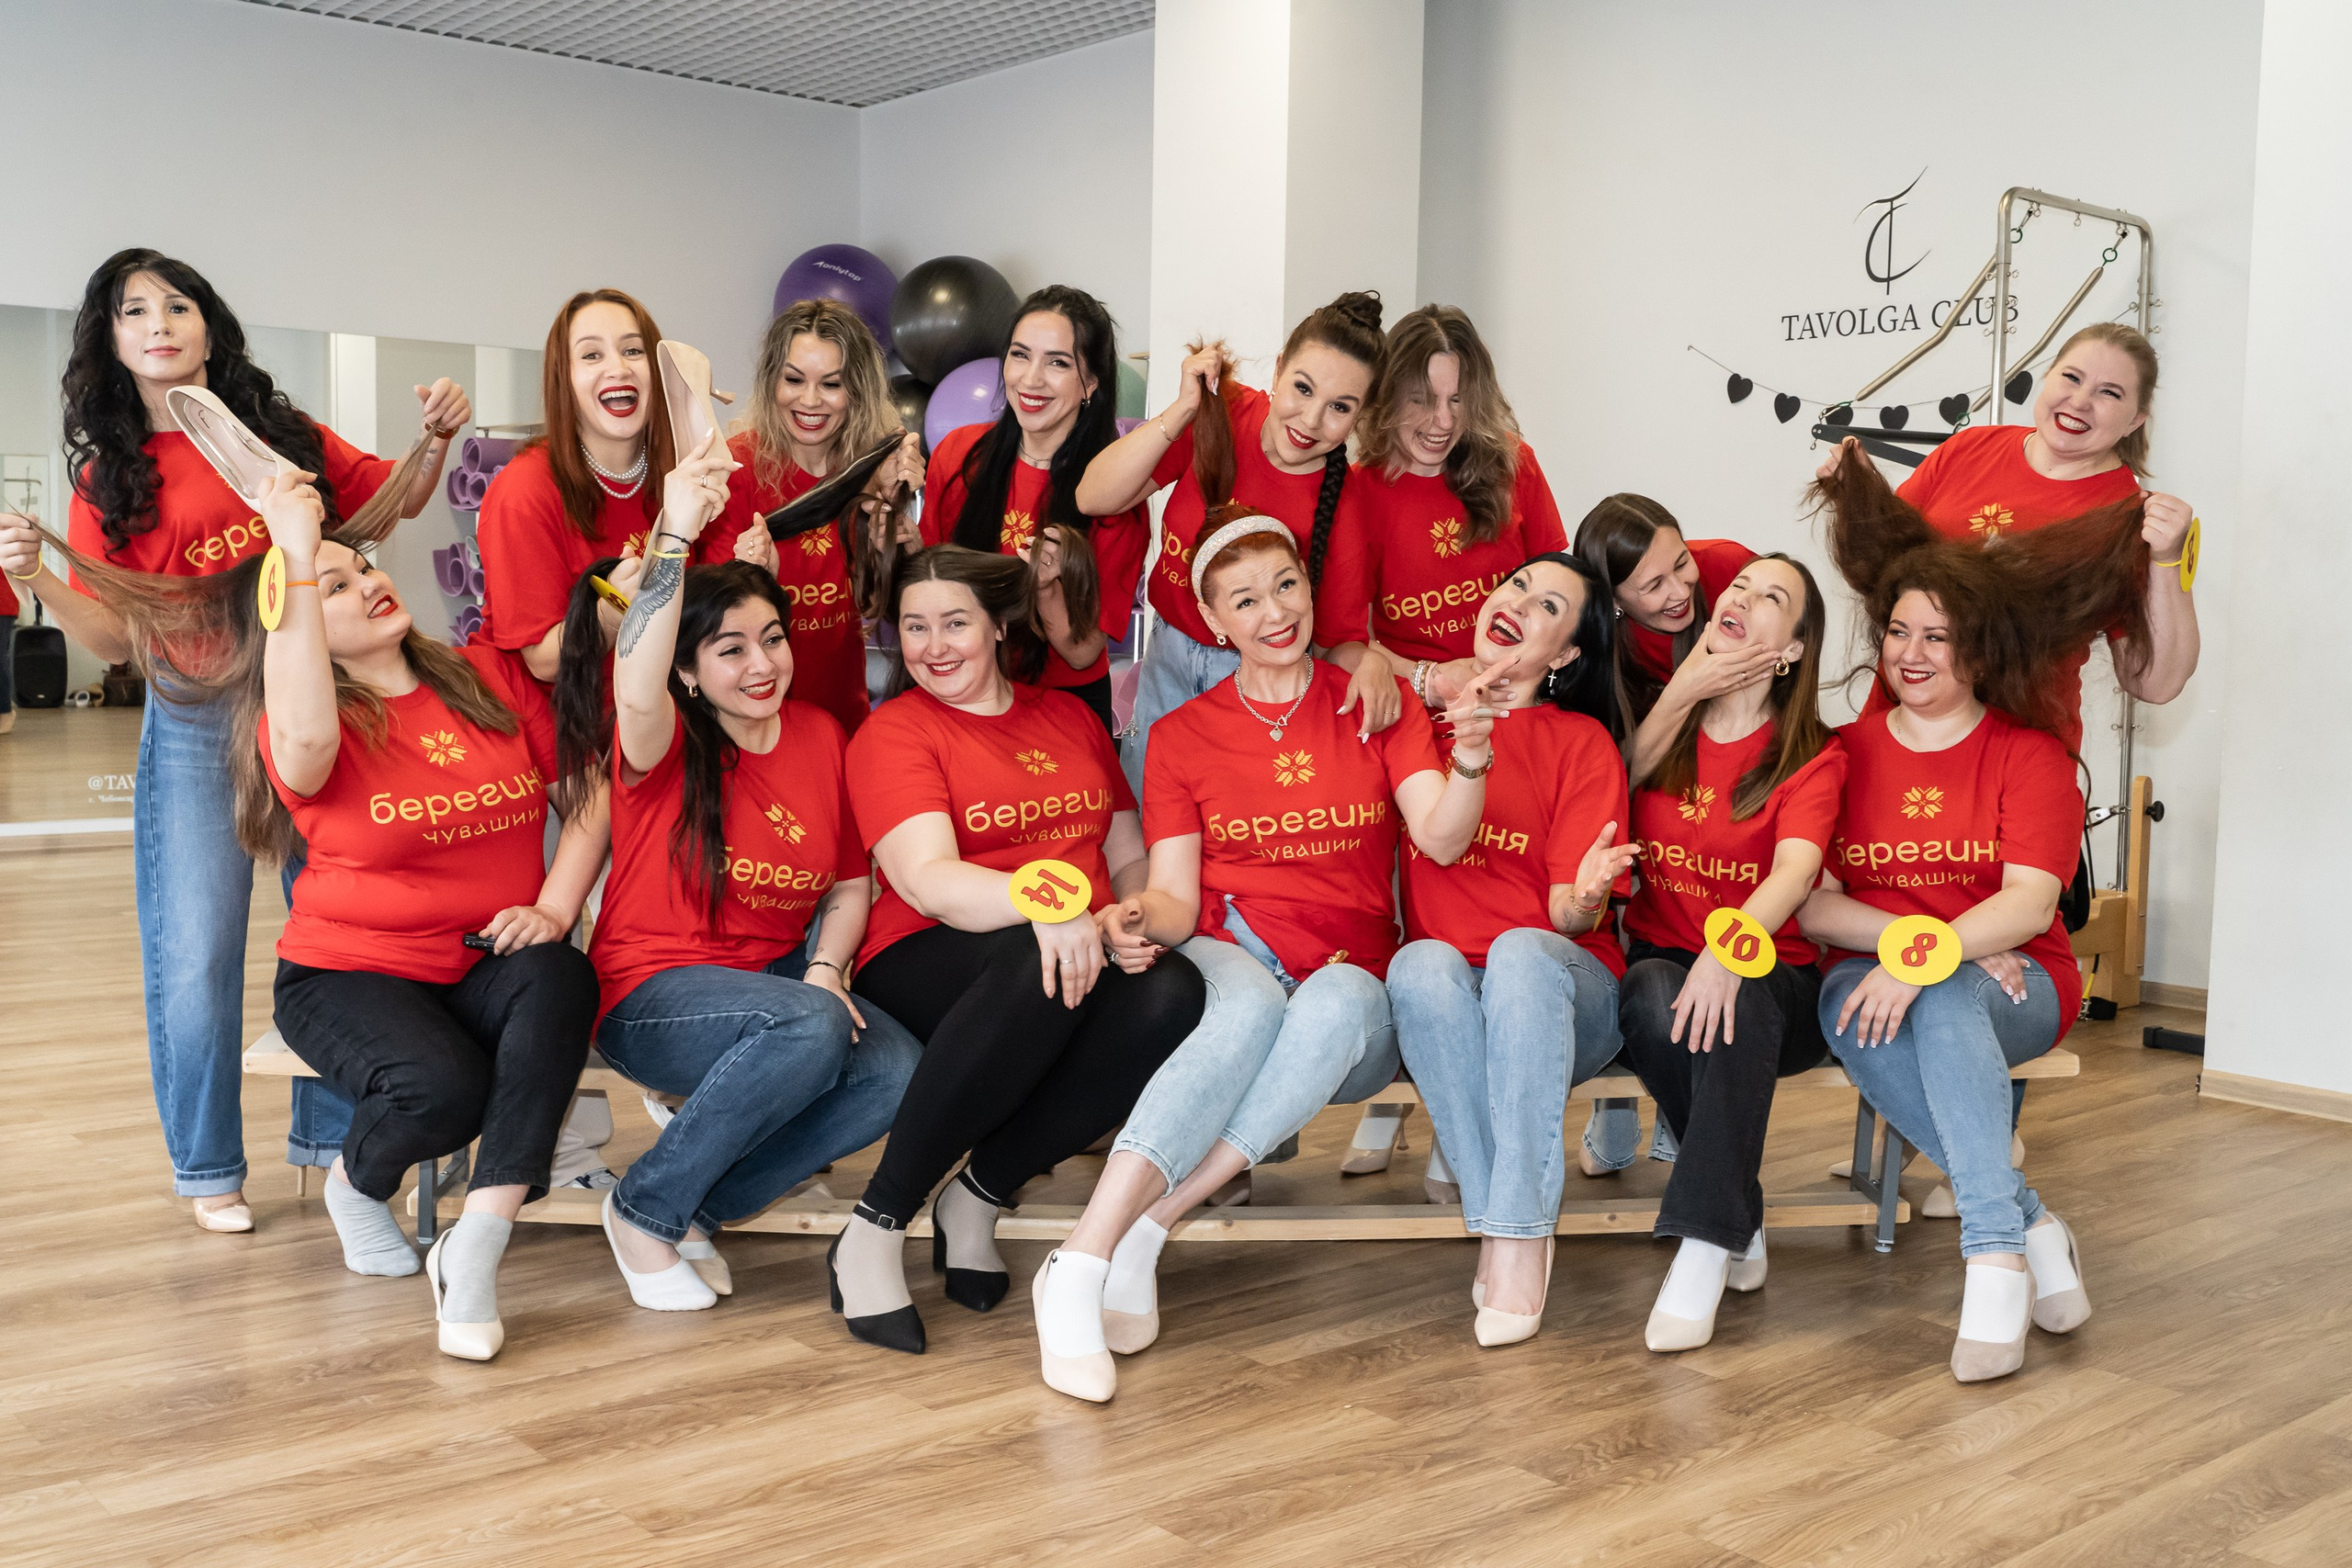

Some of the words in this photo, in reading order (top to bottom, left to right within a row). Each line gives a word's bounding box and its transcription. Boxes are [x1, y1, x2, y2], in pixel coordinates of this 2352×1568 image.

[1781, 303, 1921, 342] TAVOLGA
[1382, 570, 1507, 621] береги
[423, 807, 539, 844] чувашии
[1207, 800, 1385, 844] берегиня
[1250, 838, 1362, 863] чувашии
[1021, 868, 1080, 910] 14
[1866, 872, 1976, 888] чувашии
[1716, 918, 1761, 963] 10
[1900, 932, 1938, 967] 8
